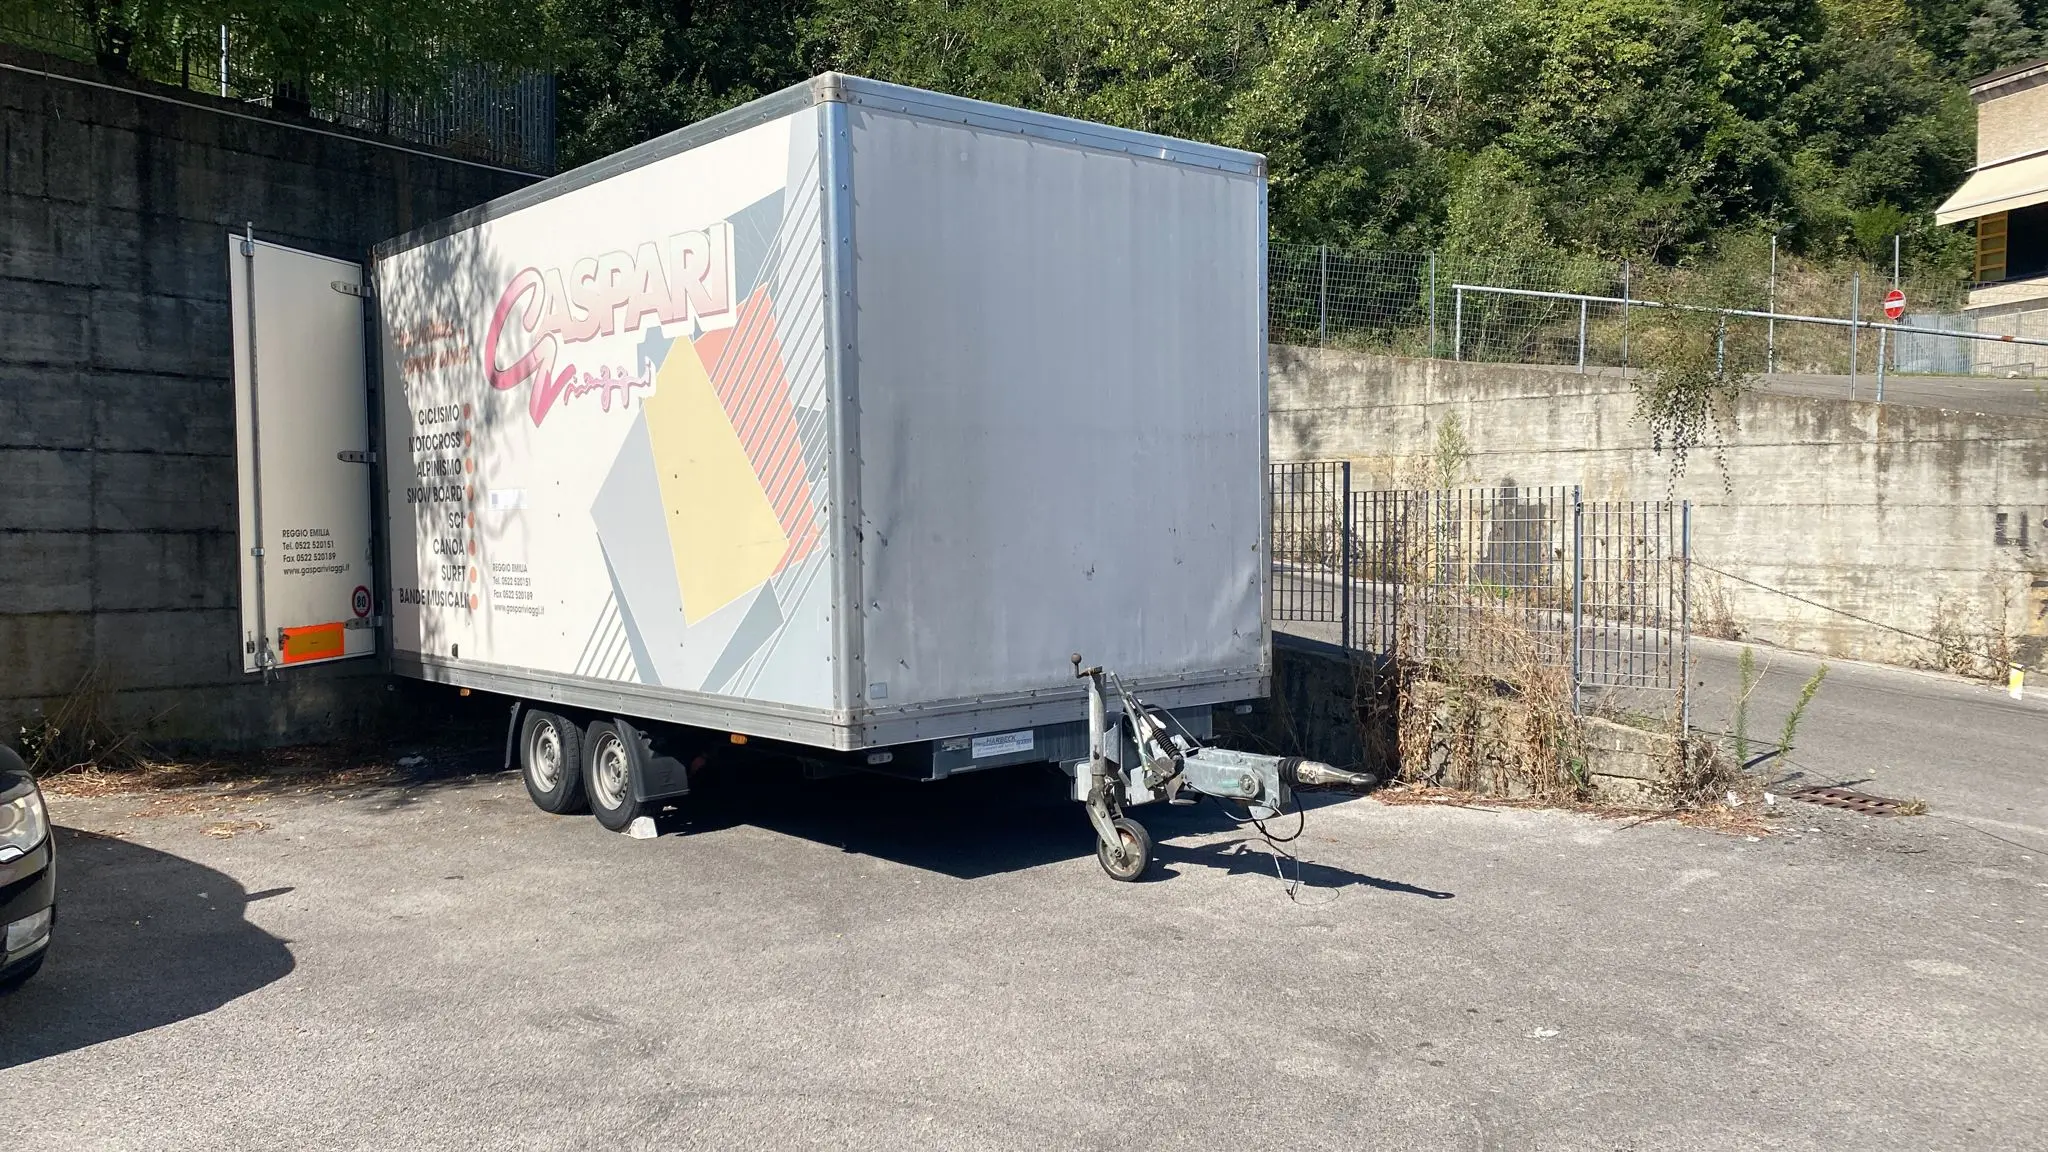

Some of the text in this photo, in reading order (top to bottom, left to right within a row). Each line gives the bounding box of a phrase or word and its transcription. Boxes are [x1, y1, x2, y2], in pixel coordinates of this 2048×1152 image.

[418, 404, 459, 426] CICLISMO
[408, 431, 461, 453] MOTOCROSS
[416, 458, 461, 478] ALPINISMO
[407, 485, 463, 504] SNOW BOARD
[282, 528, 330, 538] REGGIO EMILIA
[294, 541, 311, 550] 0522
[312, 540, 334, 549] 520151
[433, 538, 465, 555] CANOA
[283, 554, 295, 563] Fax
[296, 553, 312, 562] 0522
[356, 595, 367, 608] 80
[399, 587, 468, 609] BANDE MUSICALI
